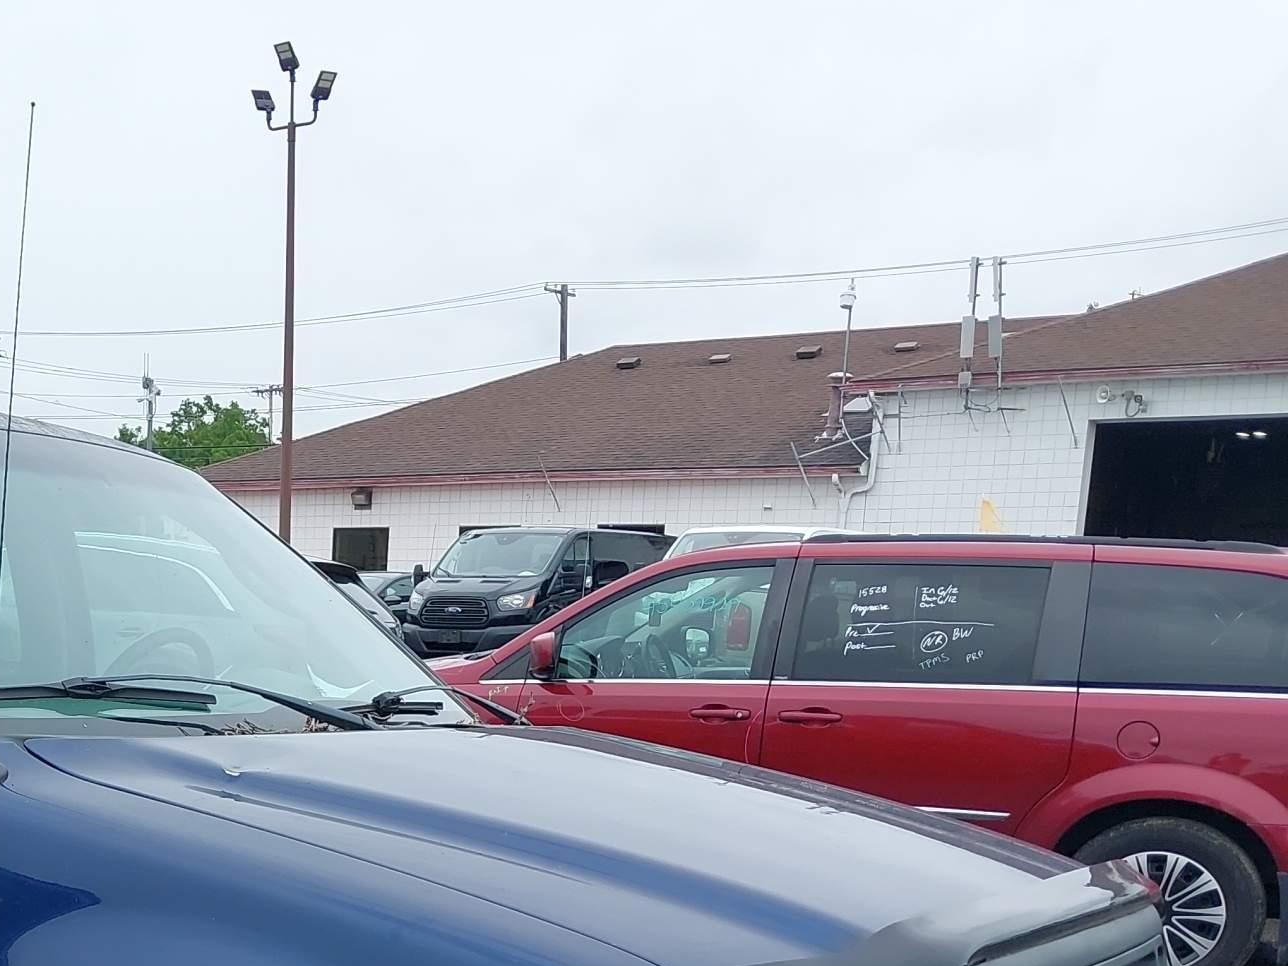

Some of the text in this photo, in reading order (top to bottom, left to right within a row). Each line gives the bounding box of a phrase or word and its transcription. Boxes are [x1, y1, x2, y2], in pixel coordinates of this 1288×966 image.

[920, 586, 936, 595] In
[952, 626, 974, 641] BW
[918, 652, 951, 671] TPMS
